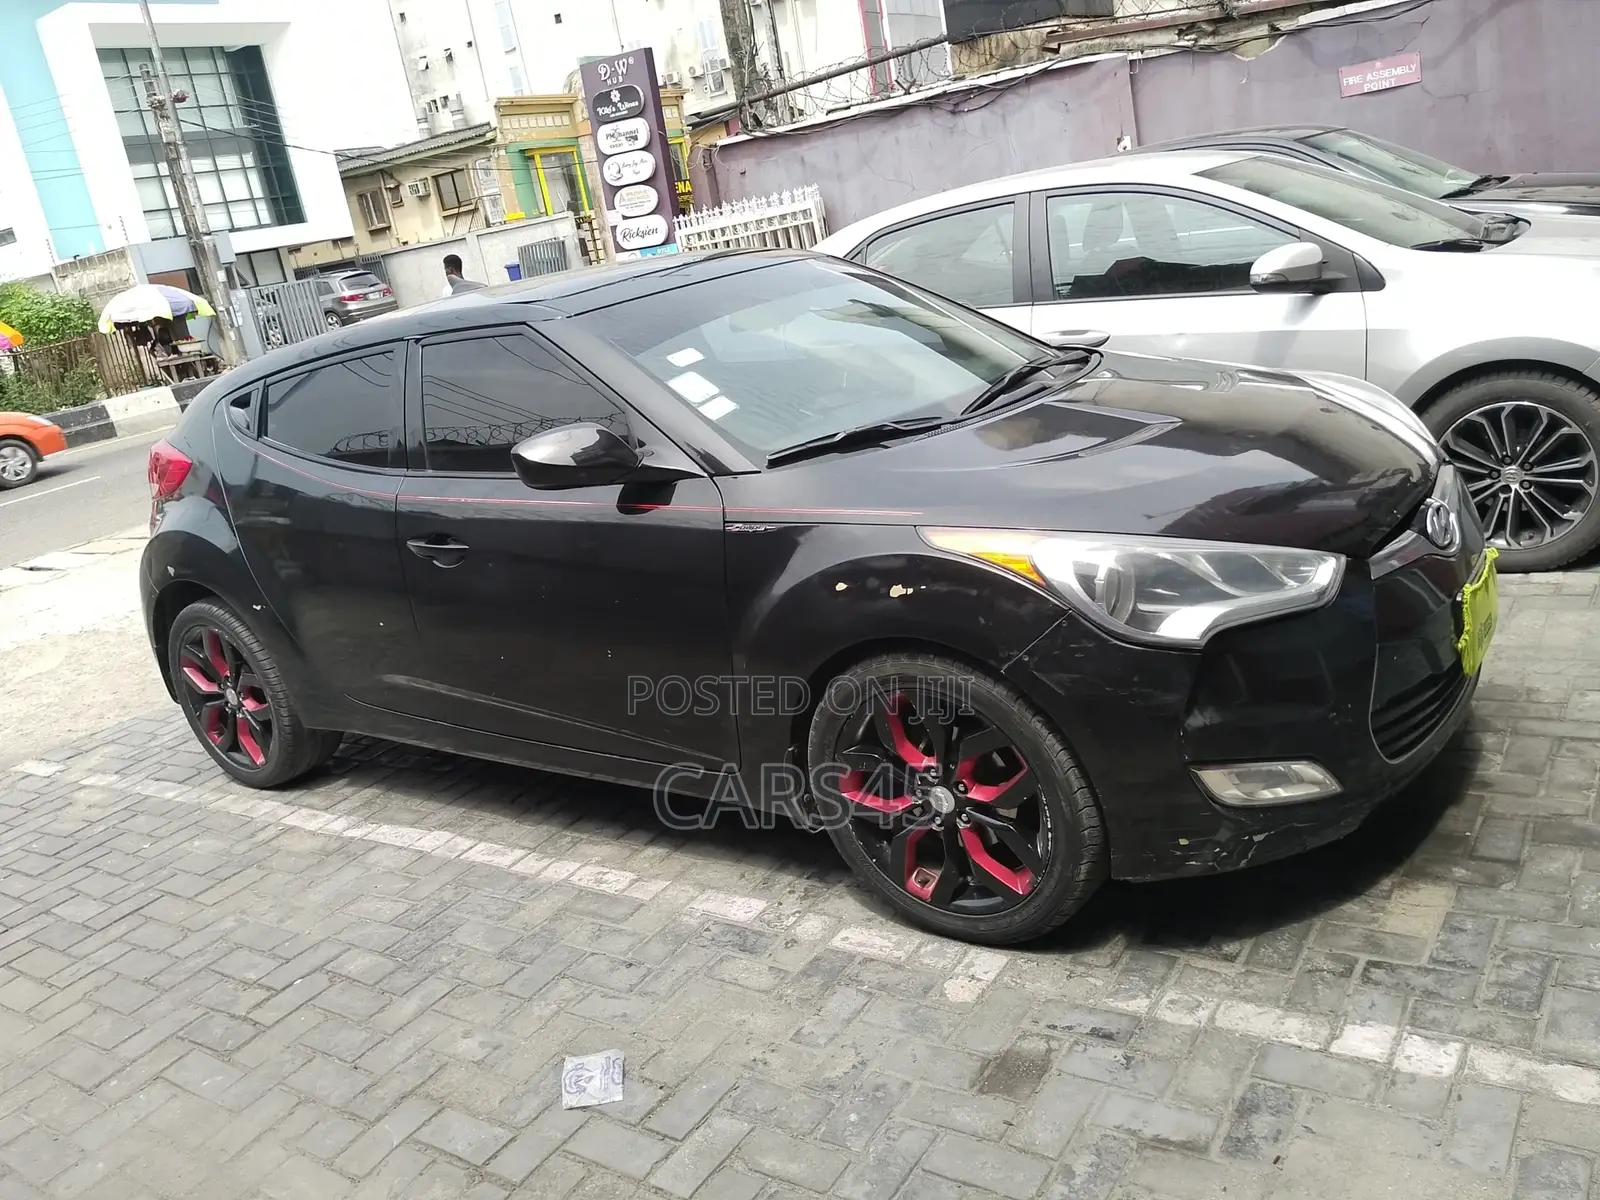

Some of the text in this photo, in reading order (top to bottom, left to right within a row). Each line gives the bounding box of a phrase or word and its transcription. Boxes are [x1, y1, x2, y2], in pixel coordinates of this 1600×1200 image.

[606, 75, 624, 86] HUB
[1343, 63, 1417, 87] FIRE ASSEMBLY
[1363, 78, 1397, 93] POINT
